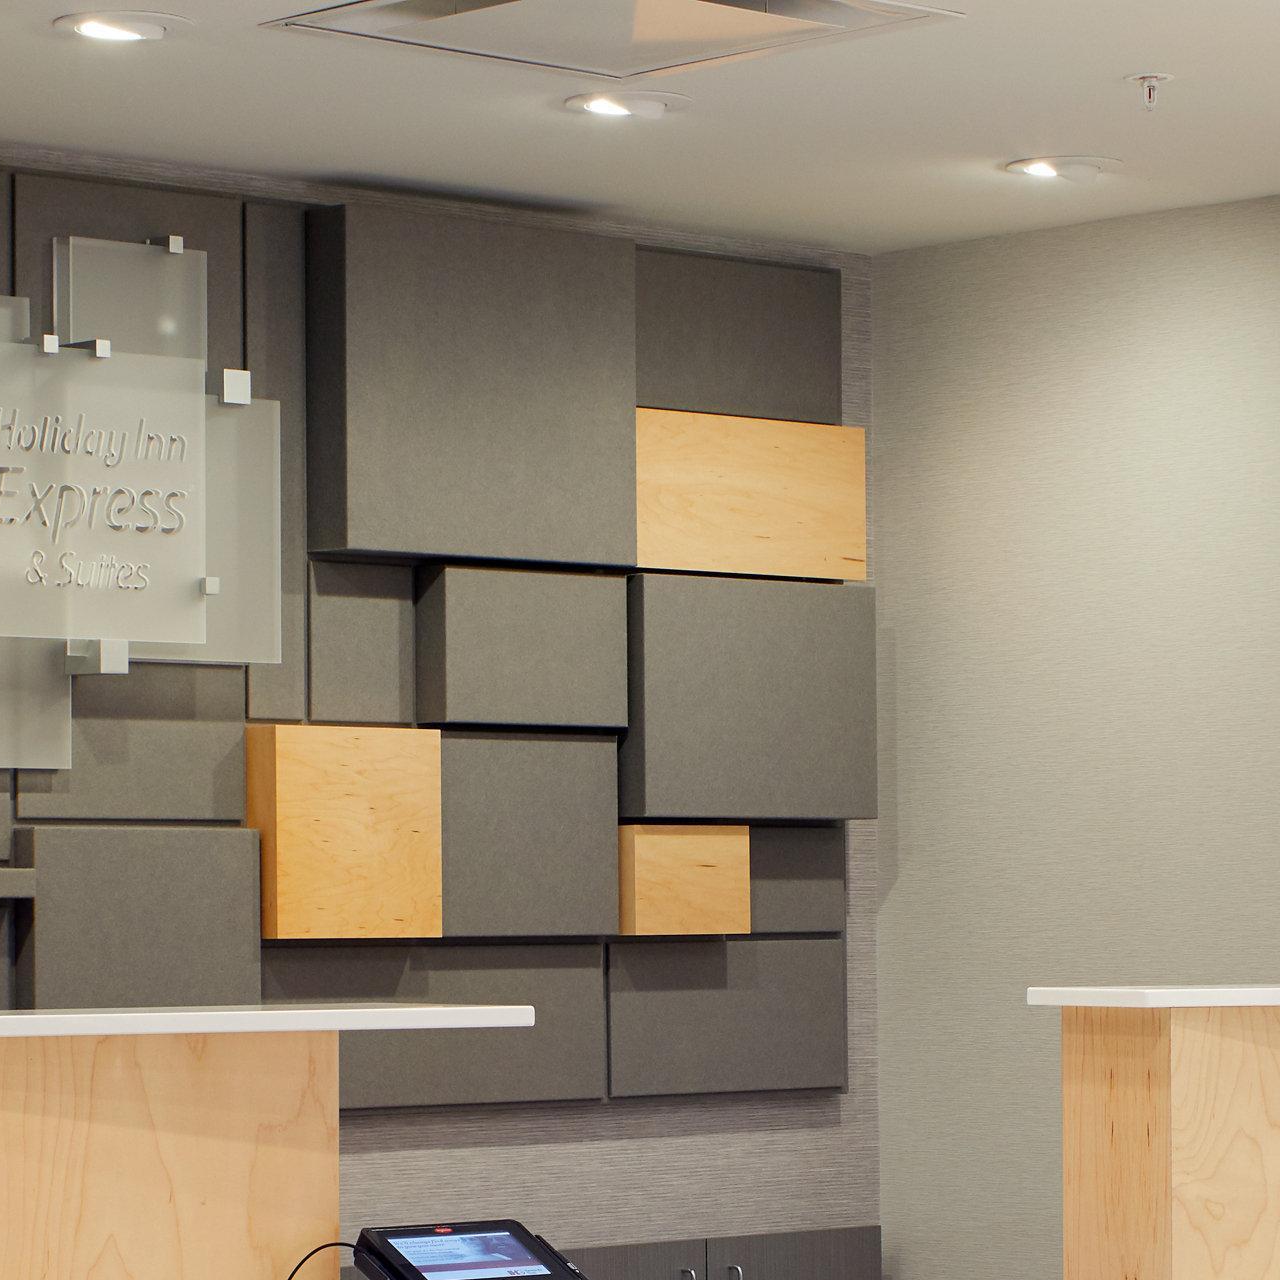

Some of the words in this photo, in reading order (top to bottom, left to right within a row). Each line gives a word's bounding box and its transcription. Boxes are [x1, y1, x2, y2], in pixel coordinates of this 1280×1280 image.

[135, 417, 187, 461] Inn
[26, 550, 48, 587] &
[55, 551, 151, 590] Suites
